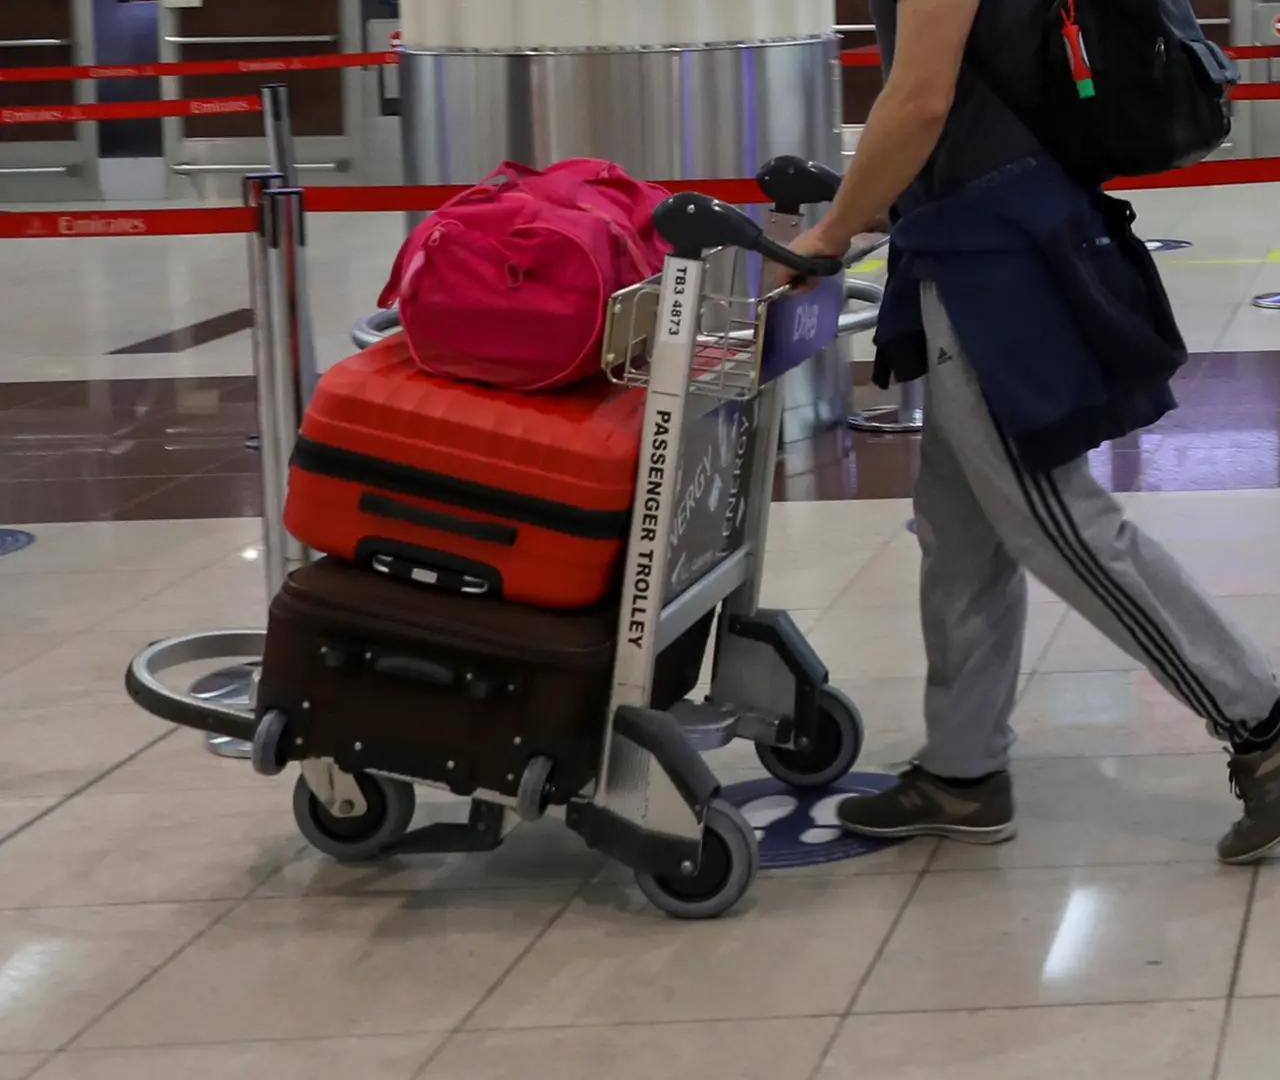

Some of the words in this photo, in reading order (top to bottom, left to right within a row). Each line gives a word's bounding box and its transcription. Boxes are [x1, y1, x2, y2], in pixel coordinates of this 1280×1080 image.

[1, 108, 63, 123] Emirates
[190, 101, 249, 114] Emirates
[57, 215, 148, 234] Emirates
[673, 266, 688, 295] TB3
[668, 300, 683, 336] 4873
[640, 409, 672, 543] PASSENGER
[627, 549, 654, 649] TROLLEY
